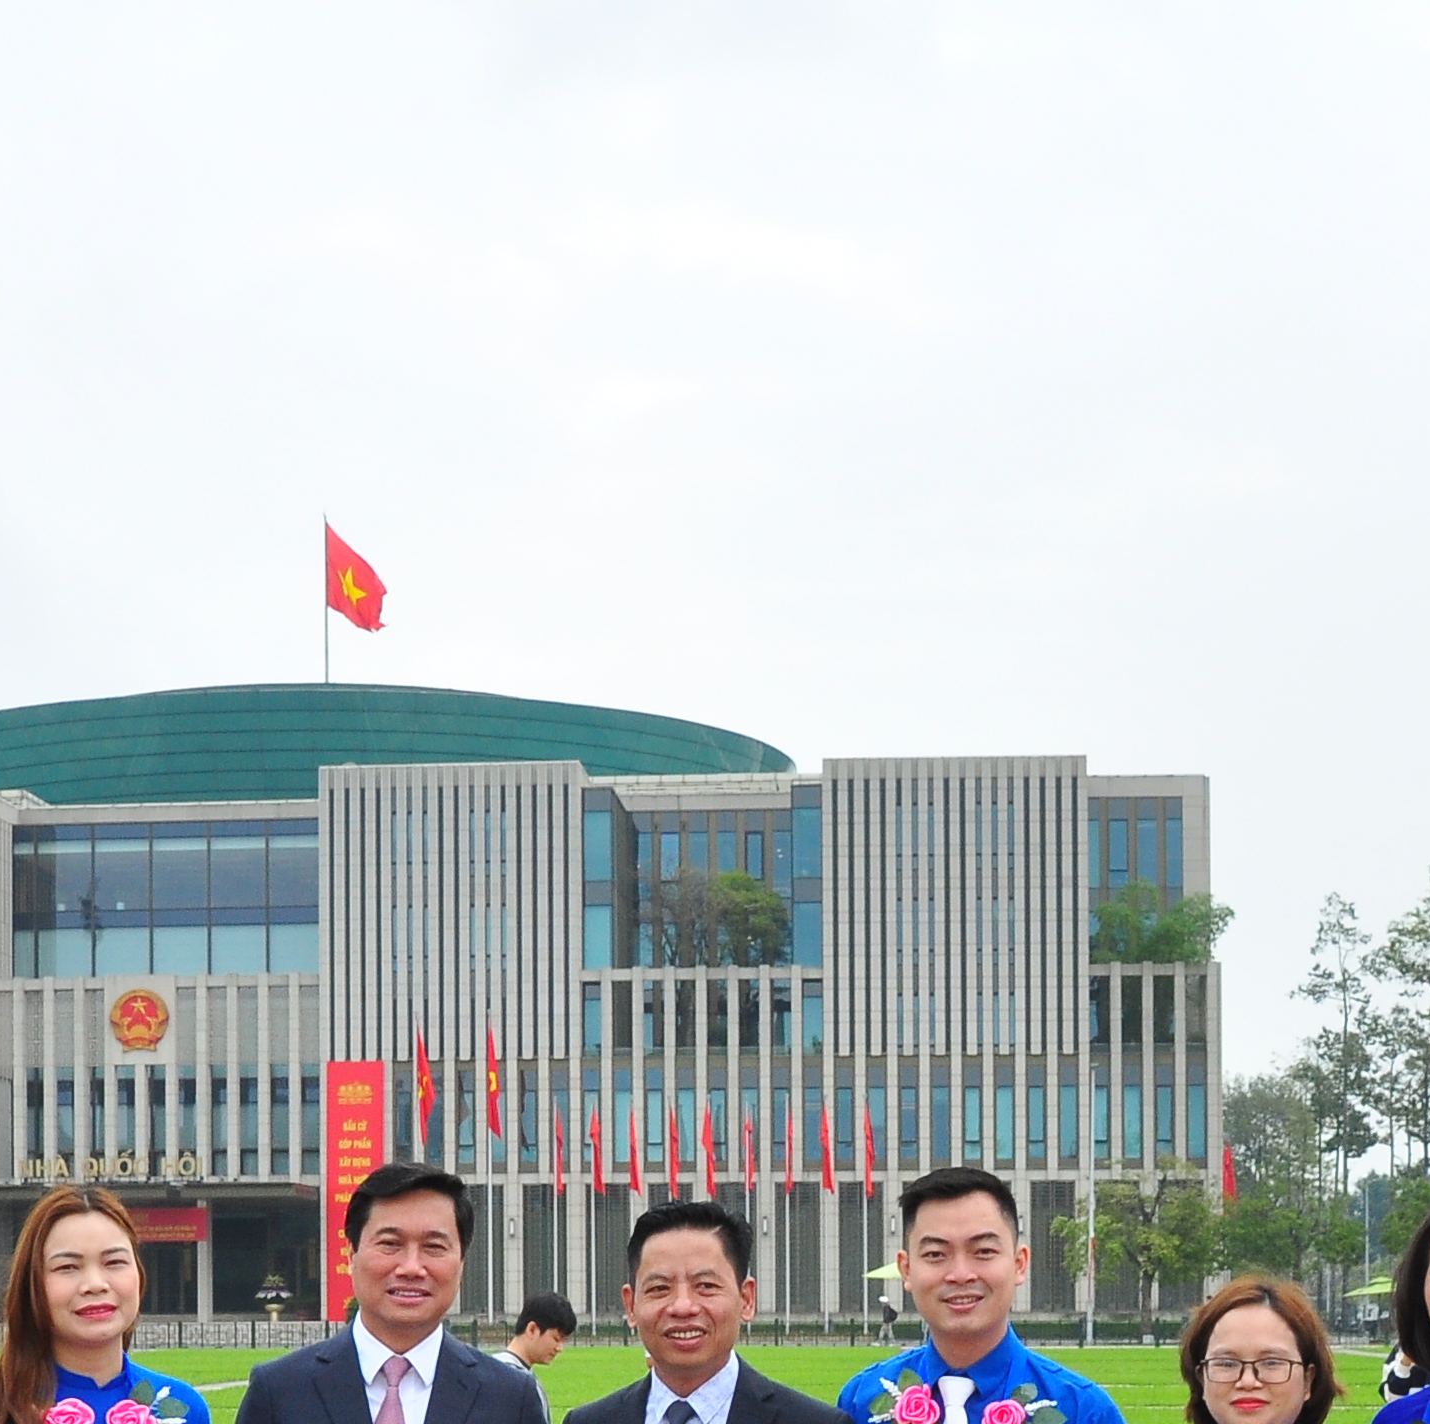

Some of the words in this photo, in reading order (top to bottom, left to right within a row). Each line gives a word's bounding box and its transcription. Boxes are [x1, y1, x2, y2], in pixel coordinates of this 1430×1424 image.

[339, 1138, 353, 1150] GÓP
[18, 1153, 69, 1178] NHÀ
[82, 1148, 150, 1178] QUỐC
